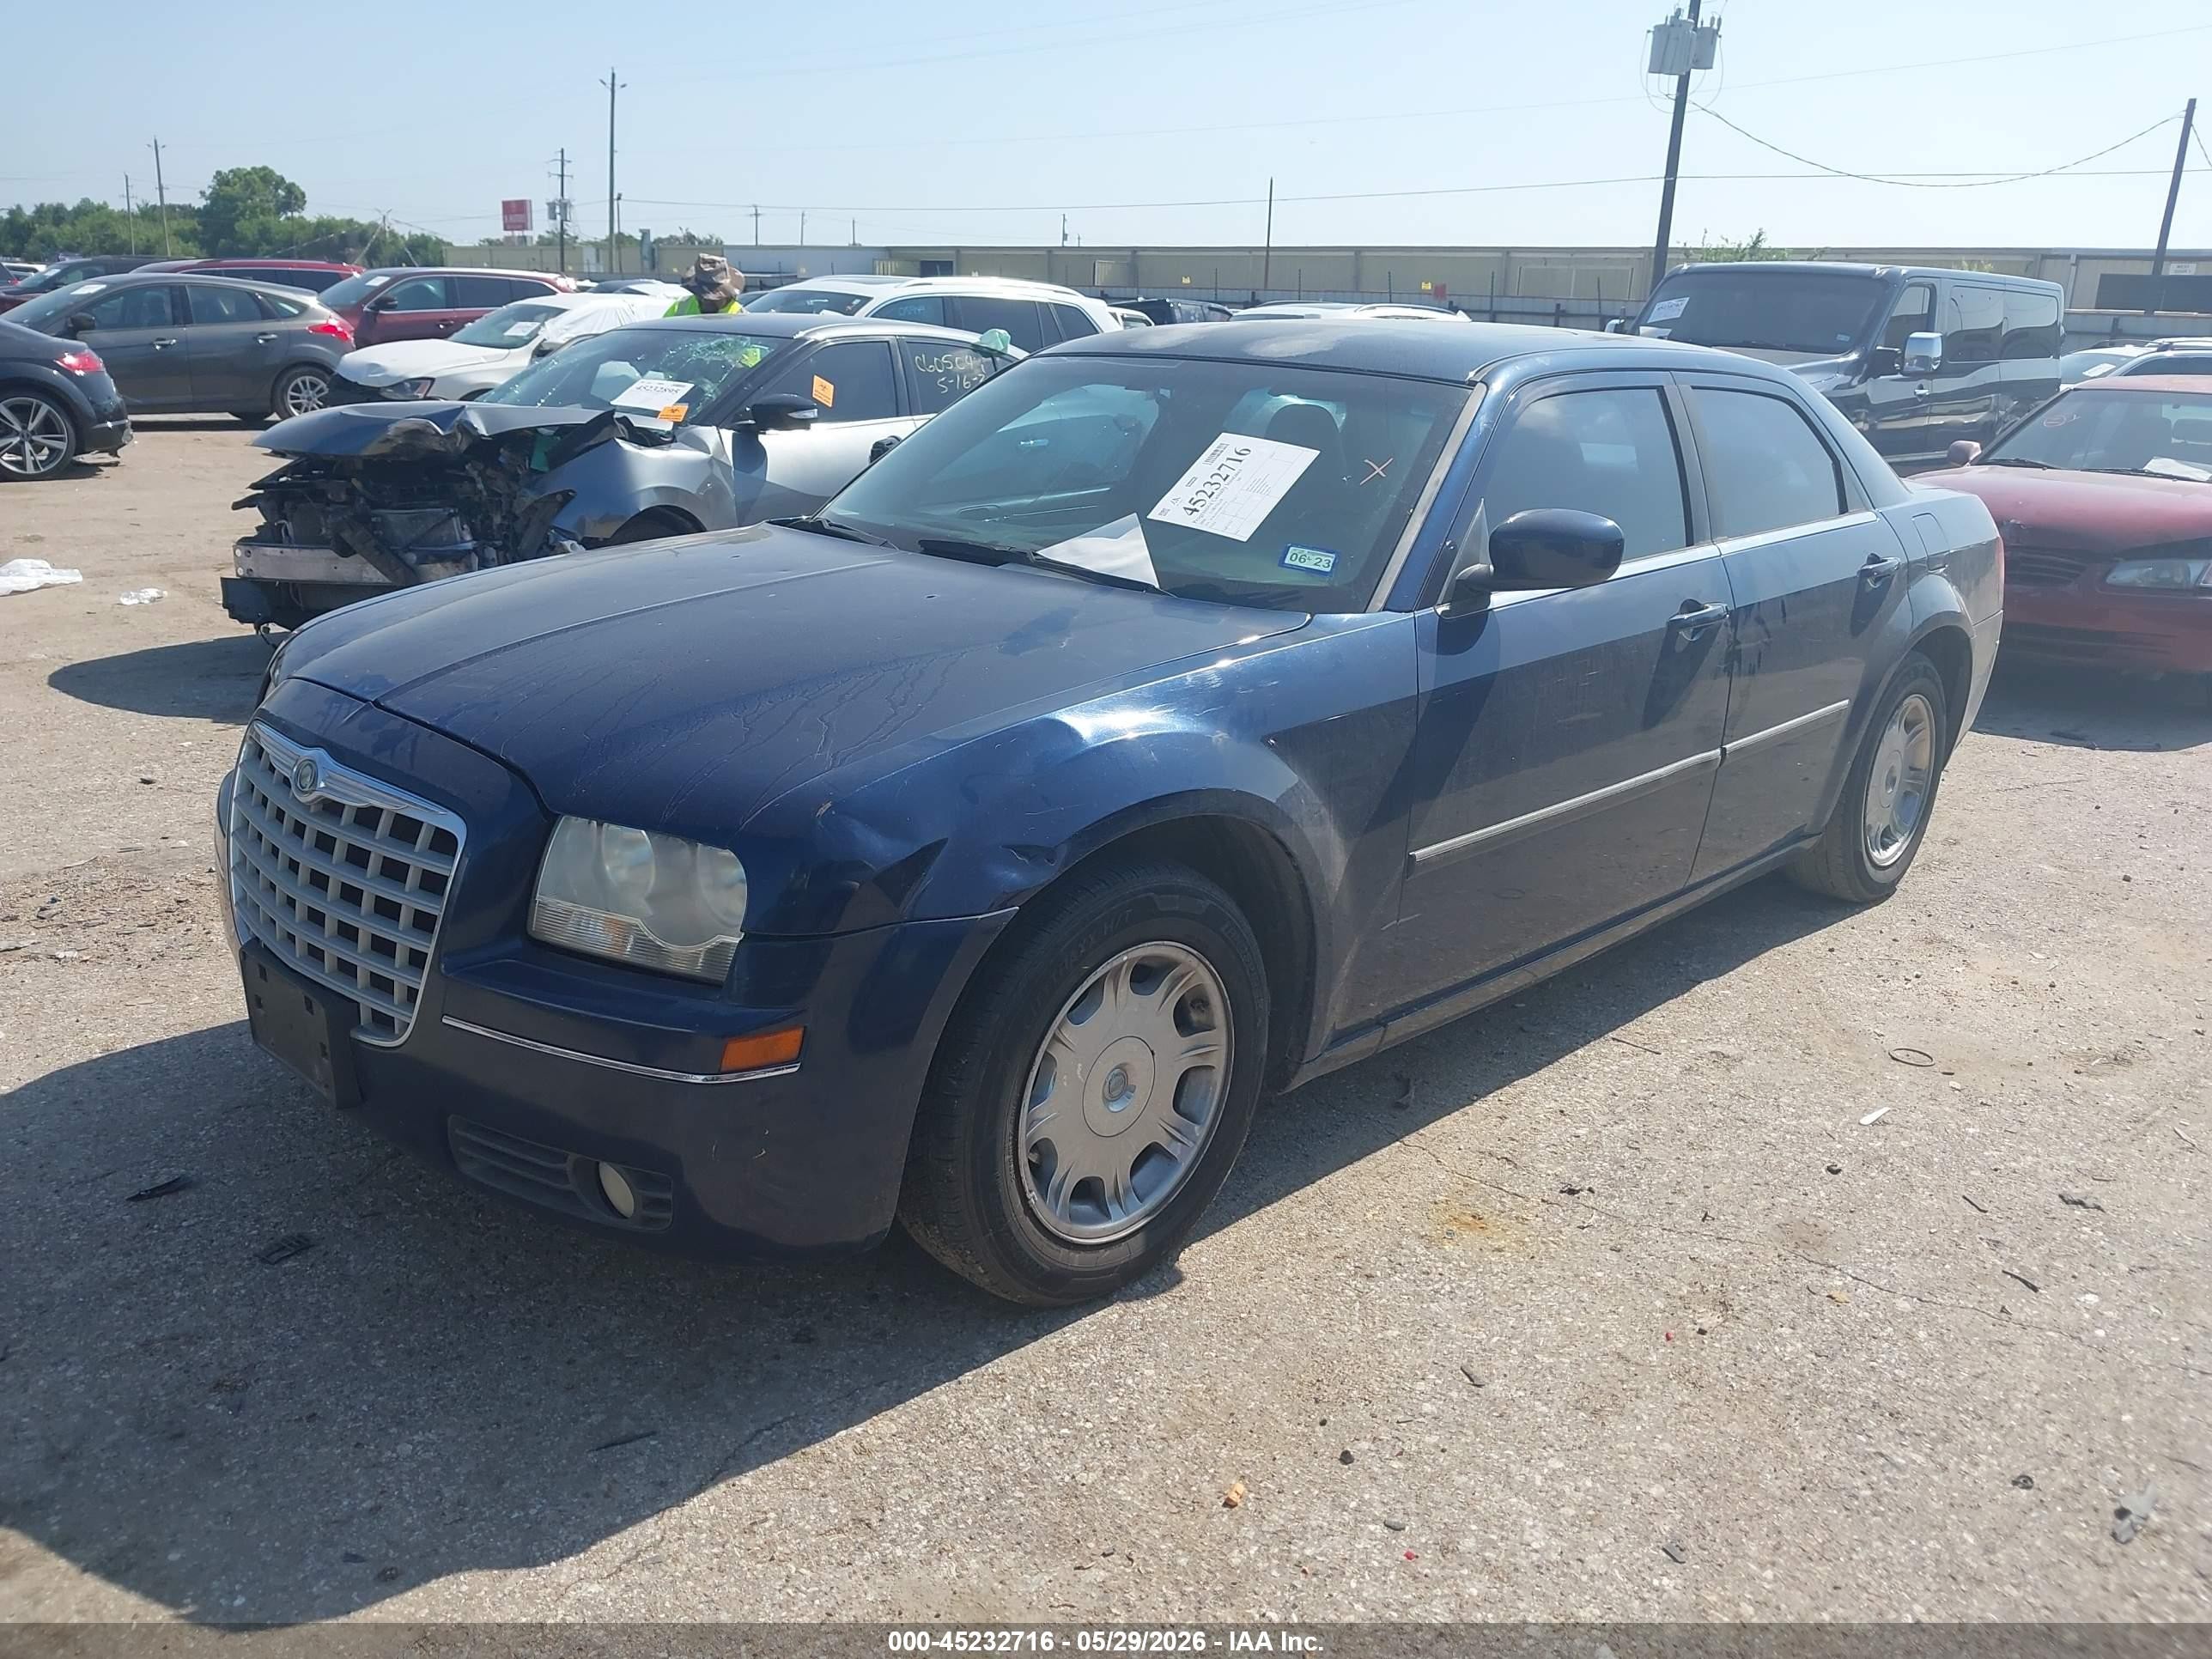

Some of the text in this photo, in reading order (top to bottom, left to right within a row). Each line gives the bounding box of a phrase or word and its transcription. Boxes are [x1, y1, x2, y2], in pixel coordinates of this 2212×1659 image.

[1182, 447, 1251, 516] 45232716
[1289, 552, 1331, 568] 06 23
